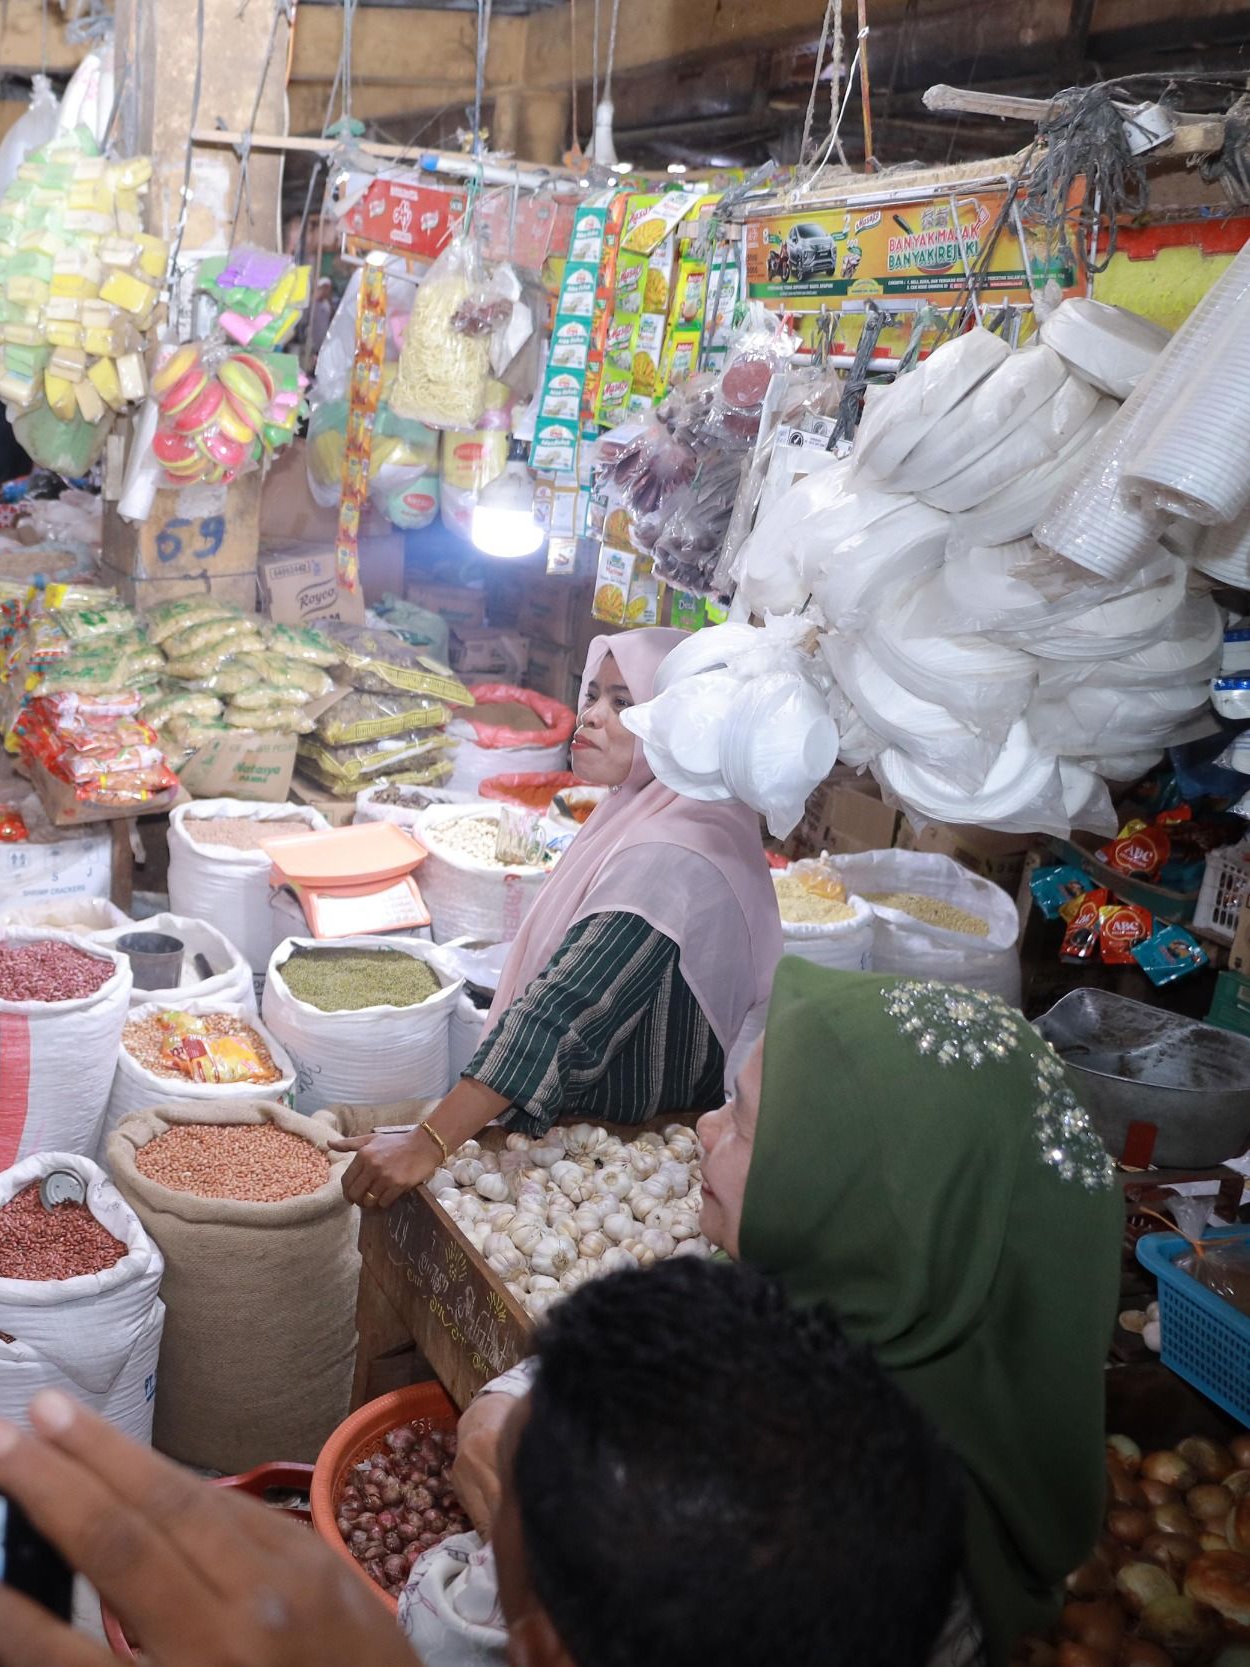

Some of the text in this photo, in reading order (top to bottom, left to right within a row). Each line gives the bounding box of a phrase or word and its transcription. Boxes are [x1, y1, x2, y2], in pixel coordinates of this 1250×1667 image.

[889, 223, 979, 252] BANYAK MAAK
[888, 247, 937, 270] BANYAK
[300, 587, 335, 611] Royco
[1124, 845, 1153, 863] ABC
[1112, 921, 1139, 931] ABC
